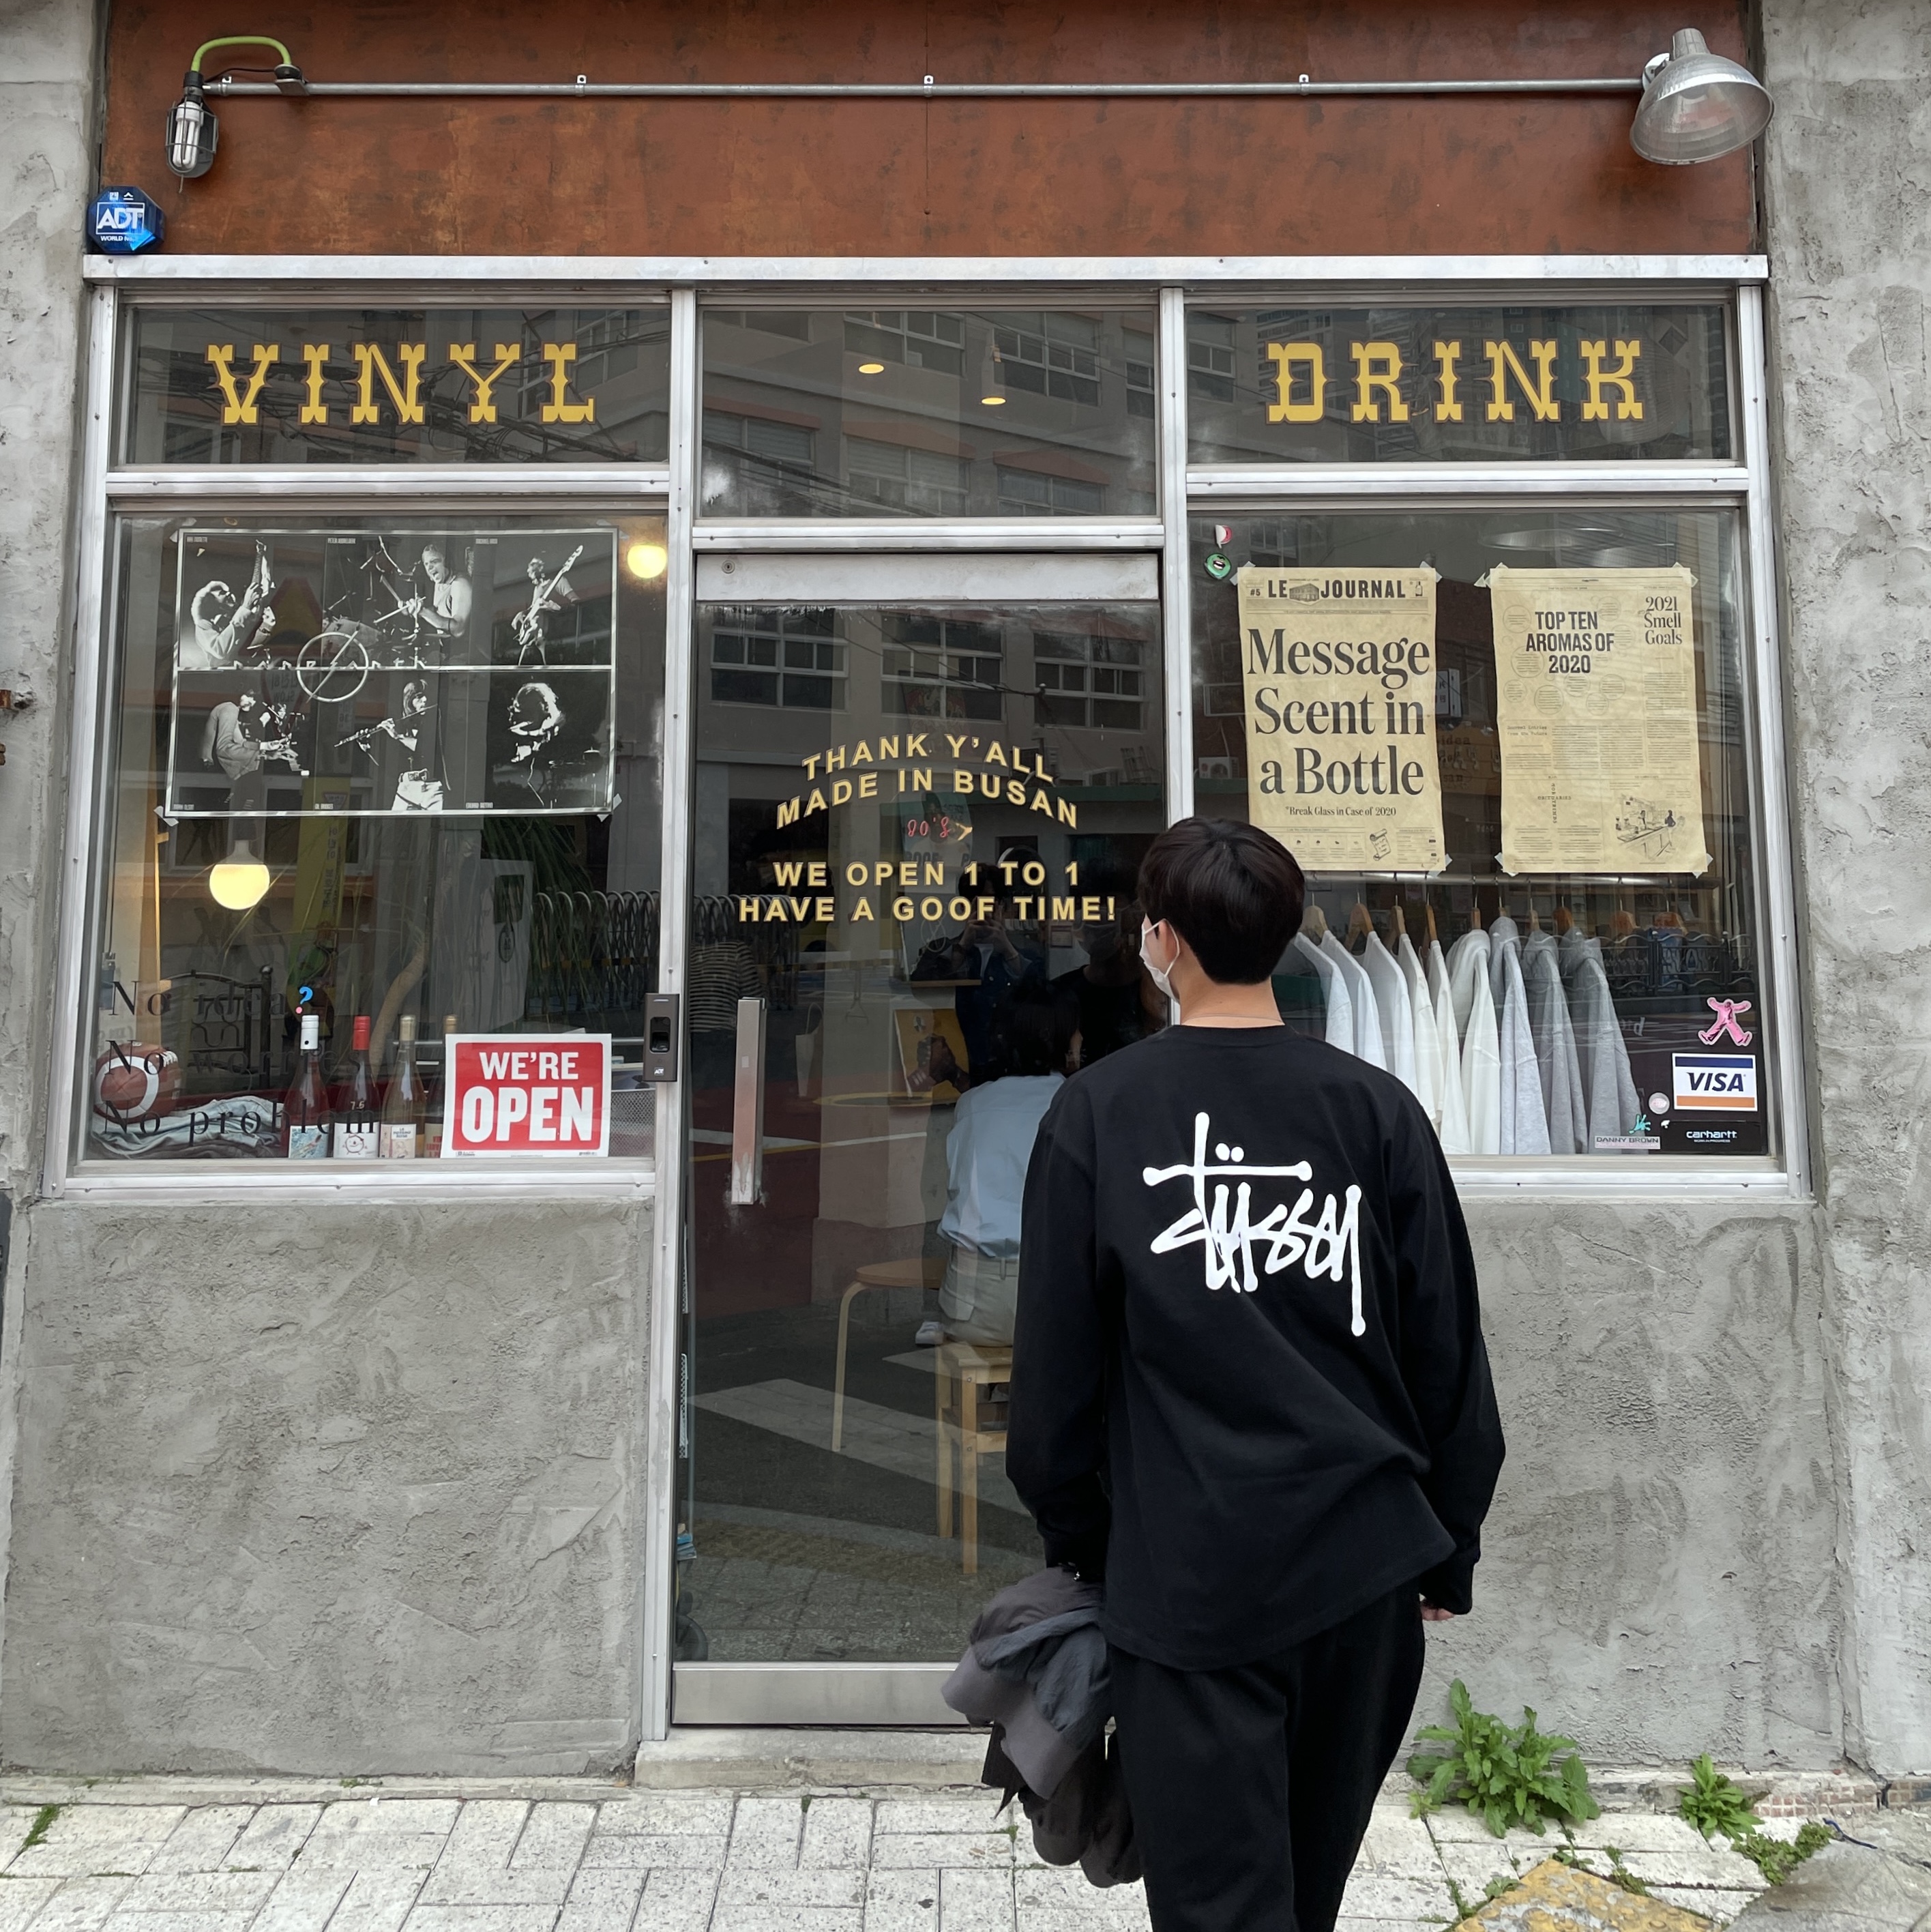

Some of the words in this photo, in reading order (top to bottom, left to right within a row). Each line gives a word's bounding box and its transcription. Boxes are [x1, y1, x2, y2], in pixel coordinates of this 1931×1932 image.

[97, 207, 144, 229] ADT
[206, 342, 596, 425] VINYL
[1266, 339, 1645, 424] DRINK
[1250, 588, 1261, 596] #5
[1267, 579, 1288, 598] LE
[1320, 579, 1406, 598] JOURNAL
[1645, 596, 1679, 612] 2021
[1535, 611, 1566, 630] TOP
[1567, 611, 1598, 630] TEN
[1644, 612, 1682, 628] Smell
[1525, 633, 1593, 652] AROMAS
[1595, 633, 1615, 652] OF
[1645, 628, 1683, 645] Goals
[1246, 628, 1430, 690] Message
[1548, 654, 1591, 673] 2020
[1254, 688, 1376, 735] Scent
[1384, 691, 1426, 735] in
[801, 733, 930, 781] THANK
[945, 733, 1058, 783] Y'ALL
[1260, 760, 1286, 794] a
[1293, 744, 1424, 795] Bottle
[776, 772, 879, 830] MADE
[898, 767, 932, 793] IN
[954, 768, 1078, 830] BUSAN
[1314, 806, 1335, 816] Glass
[1336, 806, 1344, 816] in
[1345, 806, 1364, 816] Case
[1365, 806, 1373, 816] of
[1375, 806, 1396, 816] 2020
[773, 862, 827, 887] WE
[846, 862, 945, 887] OPEN
[964, 862, 978, 887] 1
[1000, 862, 1046, 887] TO
[1064, 862, 1079, 887] 1
[739, 896, 836, 922] HAVE
[851, 896, 875, 922] A
[891, 896, 996, 922] GOOF
[1014, 896, 1116, 922] TIME!
[108, 980, 172, 1016] No
[105, 1040, 164, 1075] No
[479, 1051, 579, 1080] WE'RE
[1686, 1072, 1744, 1092] VISA
[103, 1100, 161, 1135] No
[461, 1086, 594, 1143] OPEN
[1685, 1130, 1737, 1139] carhartt
